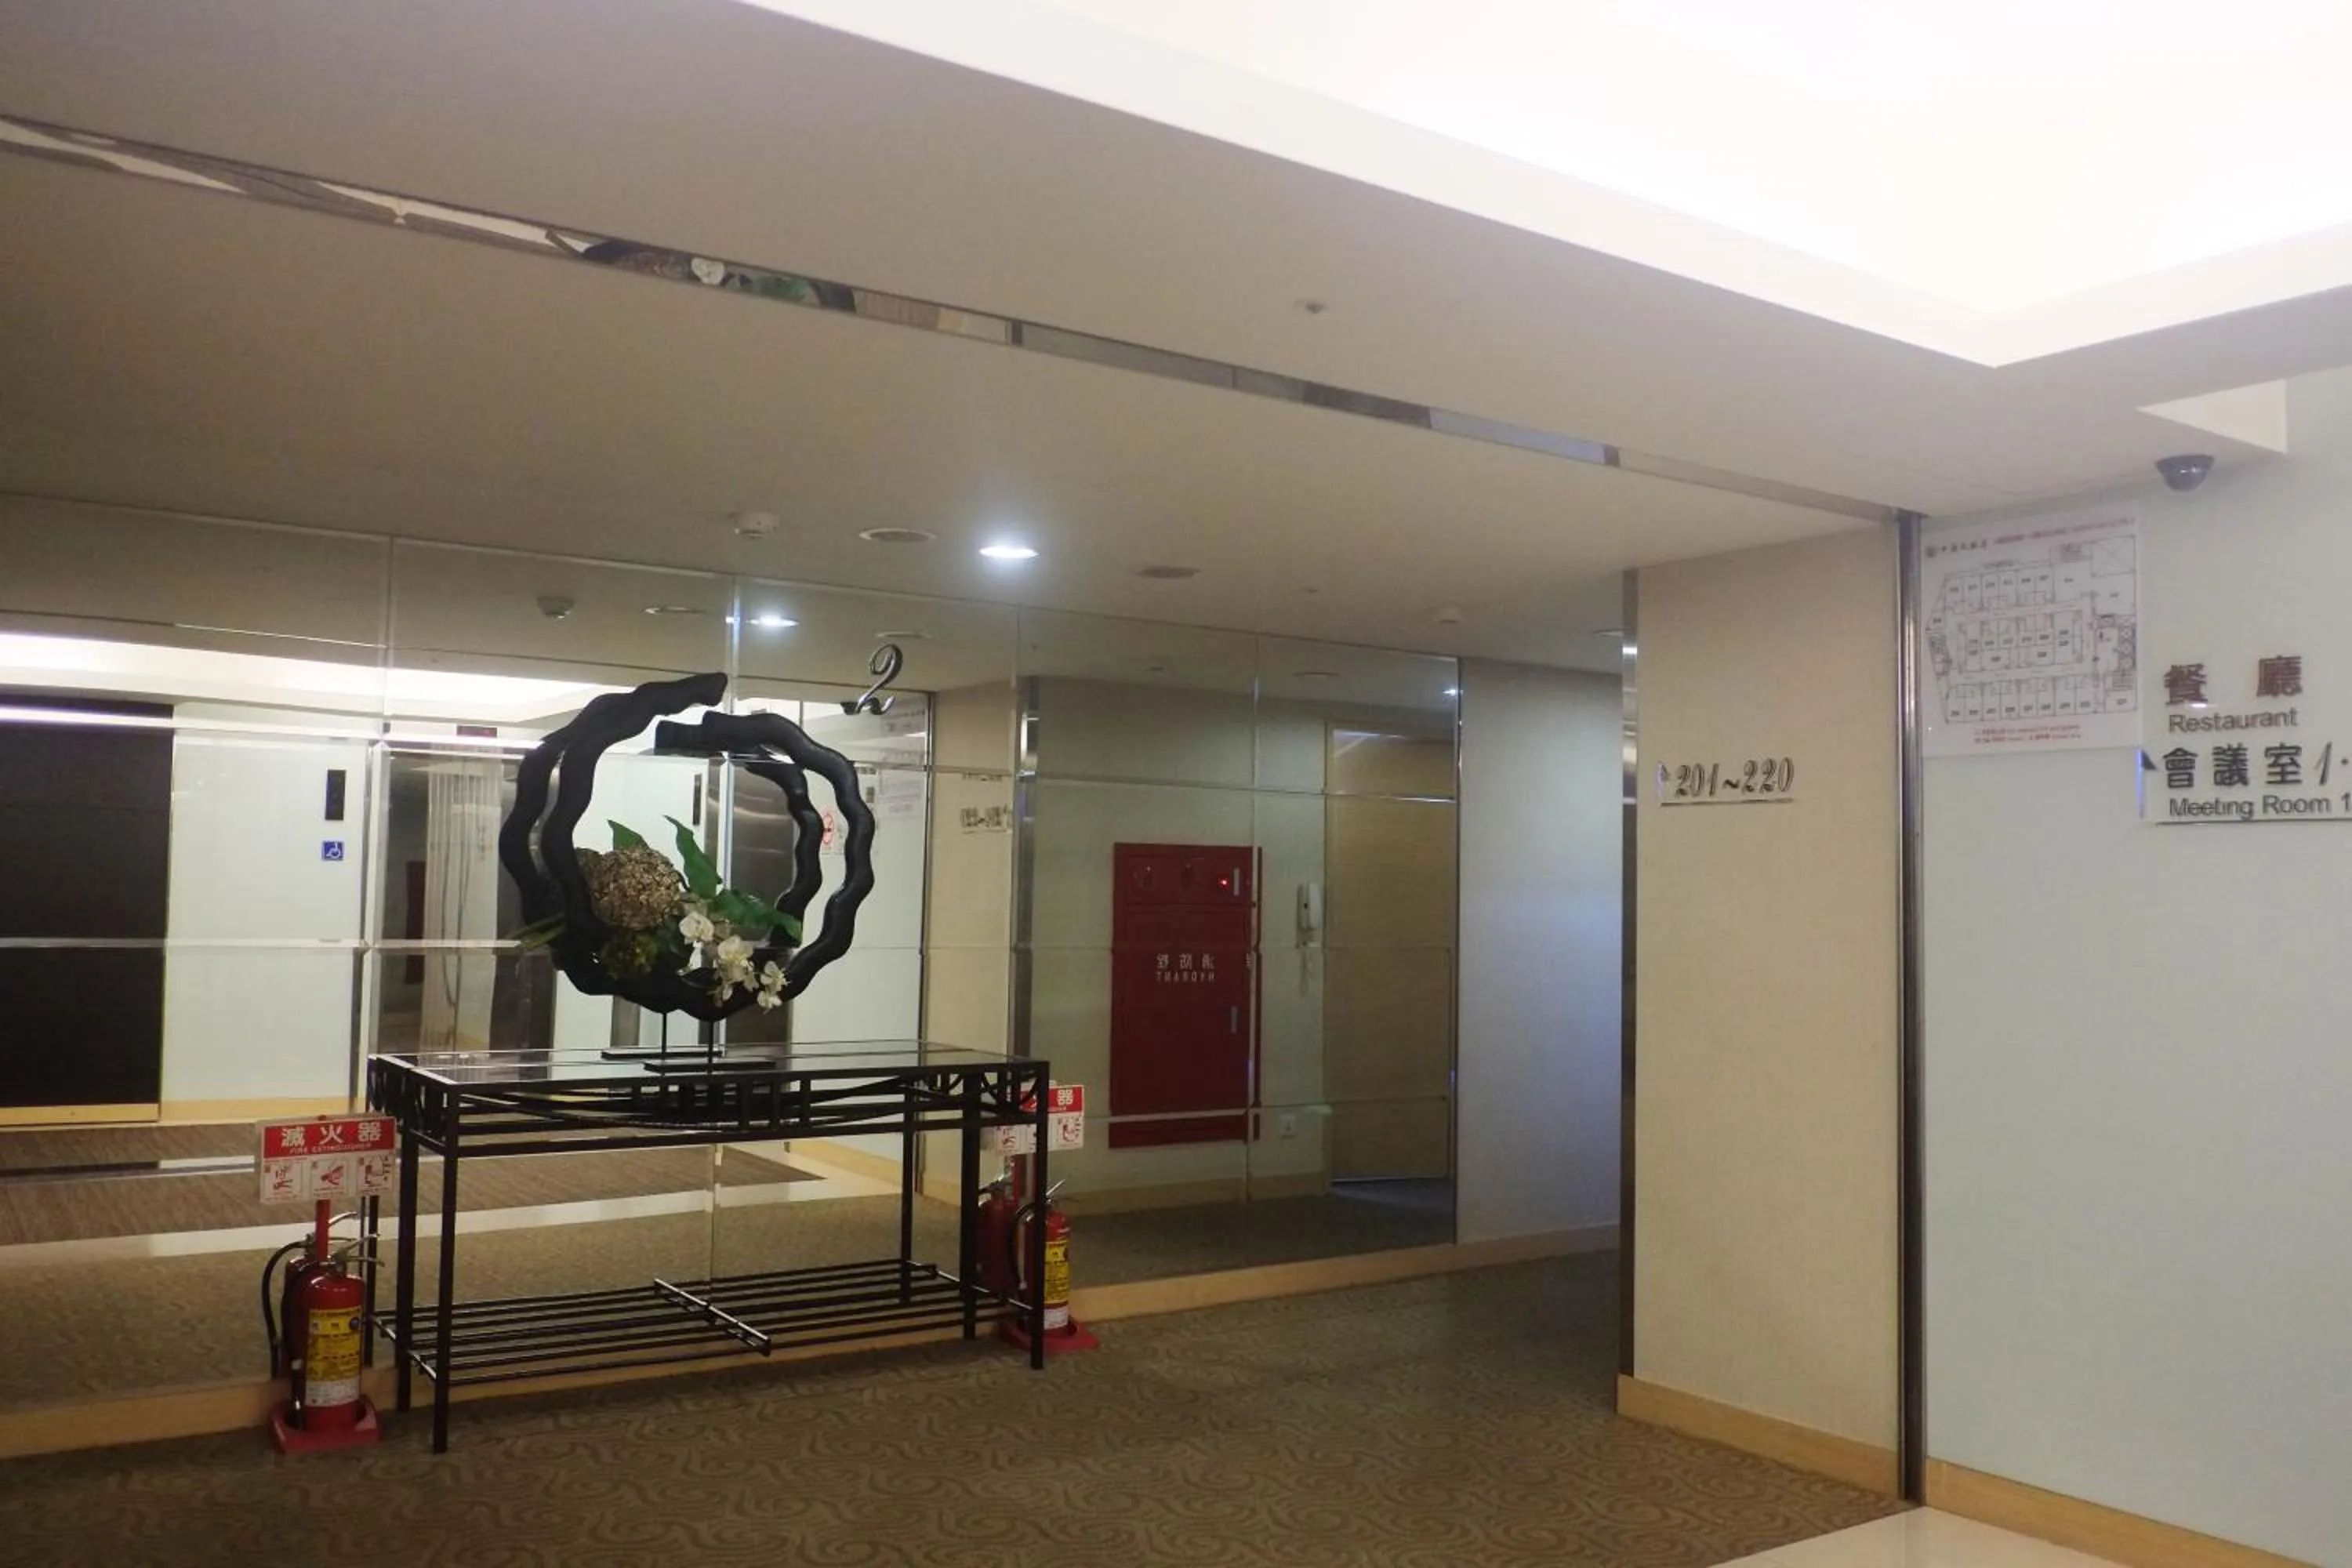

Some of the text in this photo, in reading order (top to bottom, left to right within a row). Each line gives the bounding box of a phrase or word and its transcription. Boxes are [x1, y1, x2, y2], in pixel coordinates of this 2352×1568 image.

[2163, 655, 2303, 706] 餐廳
[2169, 707, 2299, 733] Restaurant
[2169, 797, 2254, 820] Meeting
[2263, 794, 2331, 815] Room
[281, 1121, 382, 1148] 滅火器
